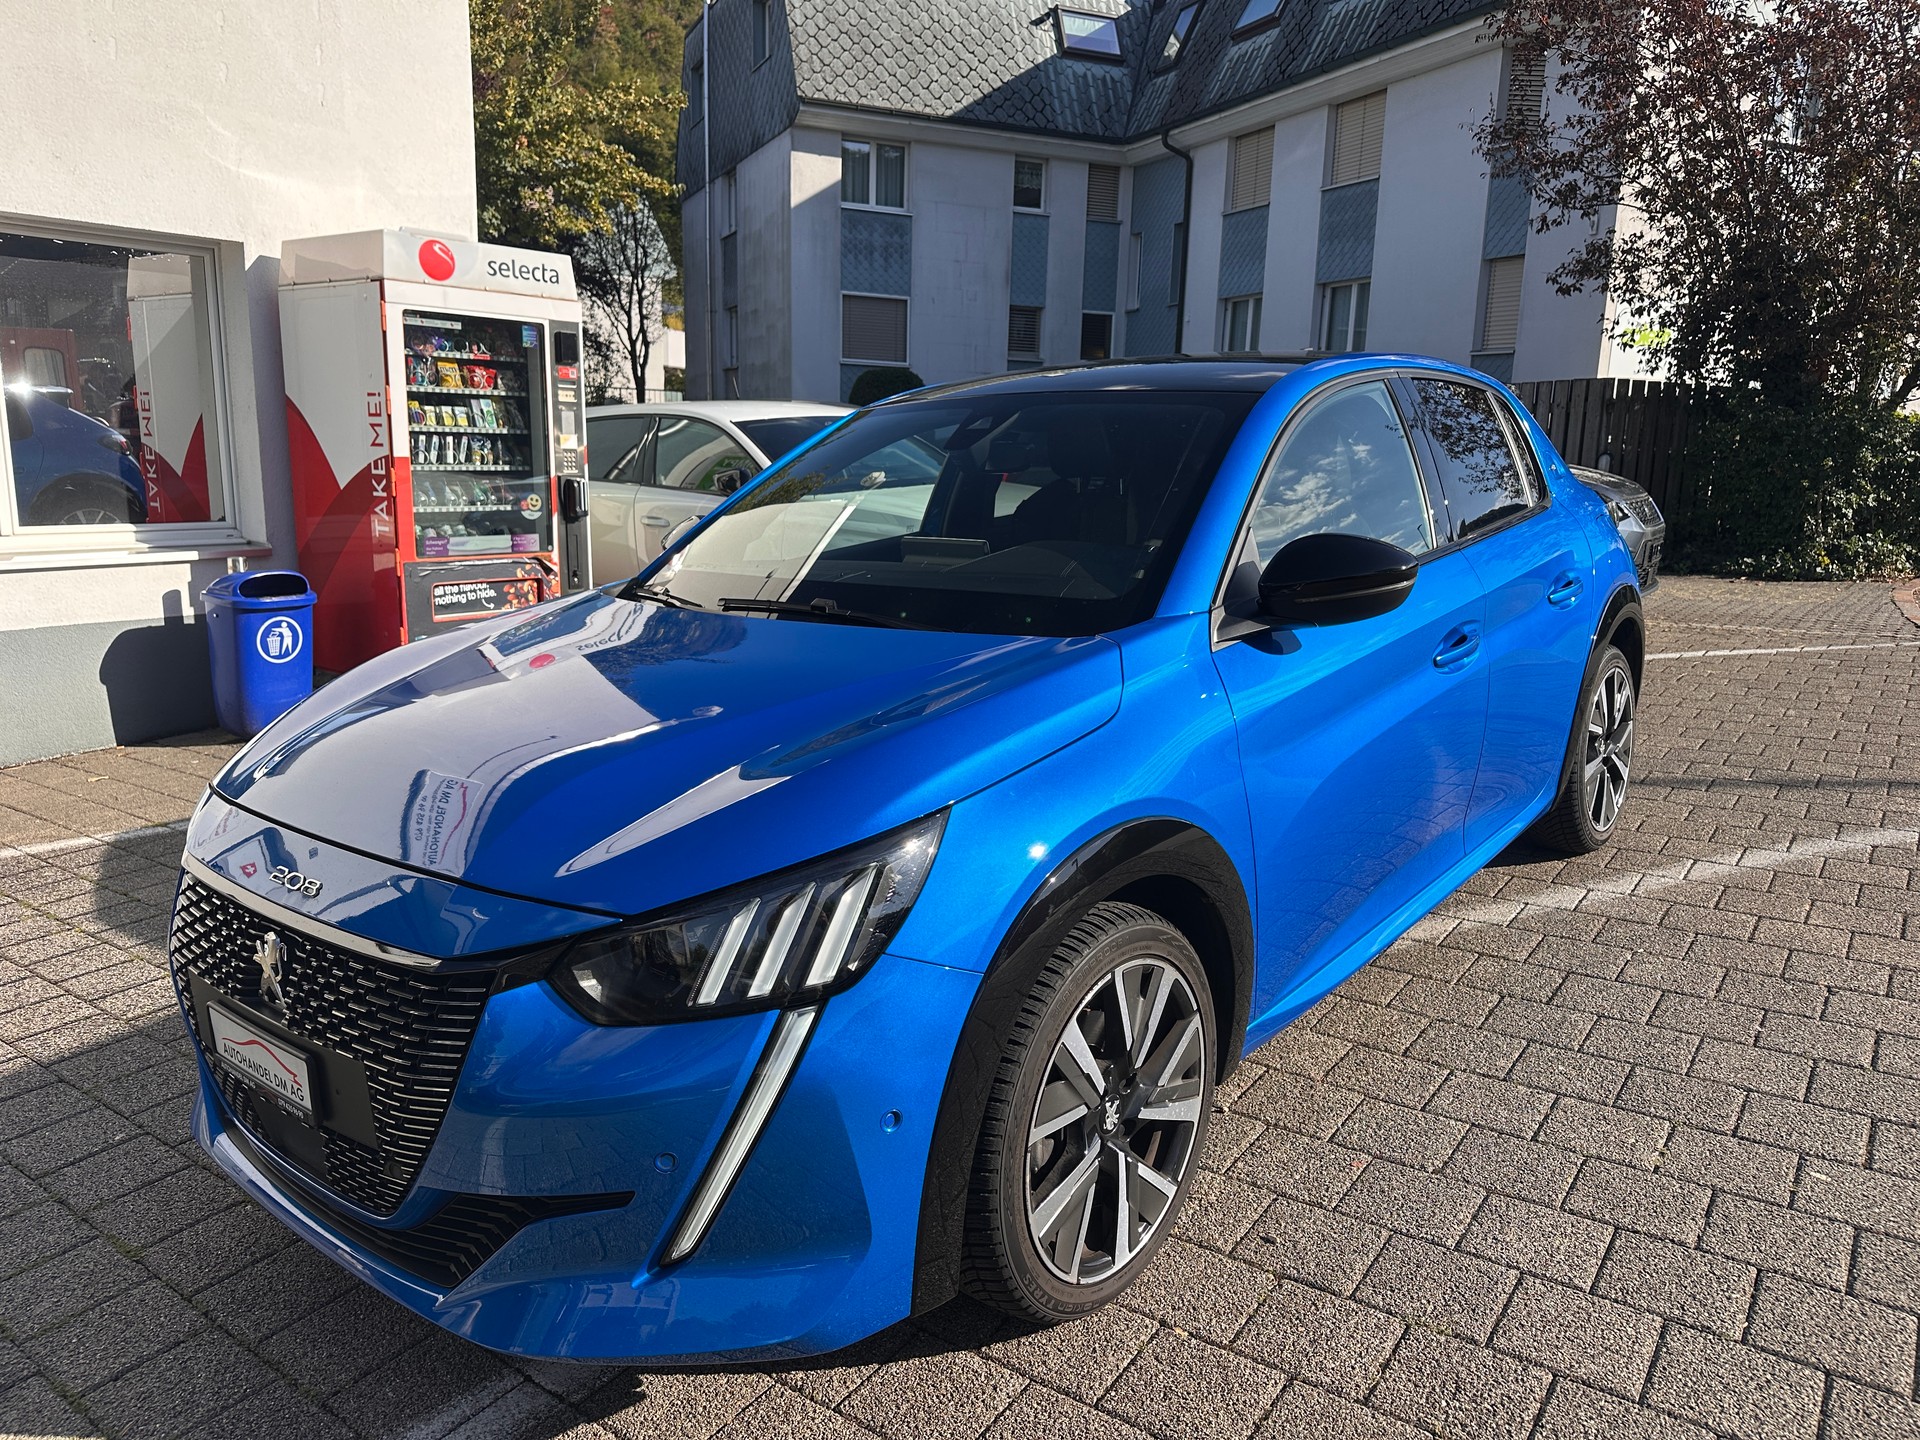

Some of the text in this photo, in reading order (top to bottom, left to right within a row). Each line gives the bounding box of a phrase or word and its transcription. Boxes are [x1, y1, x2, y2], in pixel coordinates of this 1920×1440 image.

[486, 259, 560, 285] selecta
[367, 391, 390, 537] TAKE ME!
[433, 585, 444, 596] all
[444, 584, 458, 594] the
[433, 587, 497, 605] nothing to hide.
[269, 865, 323, 898] 208
[223, 1042, 305, 1102] AUTOHANDEL DM AG
[1023, 1273, 1056, 1309] TYRES
